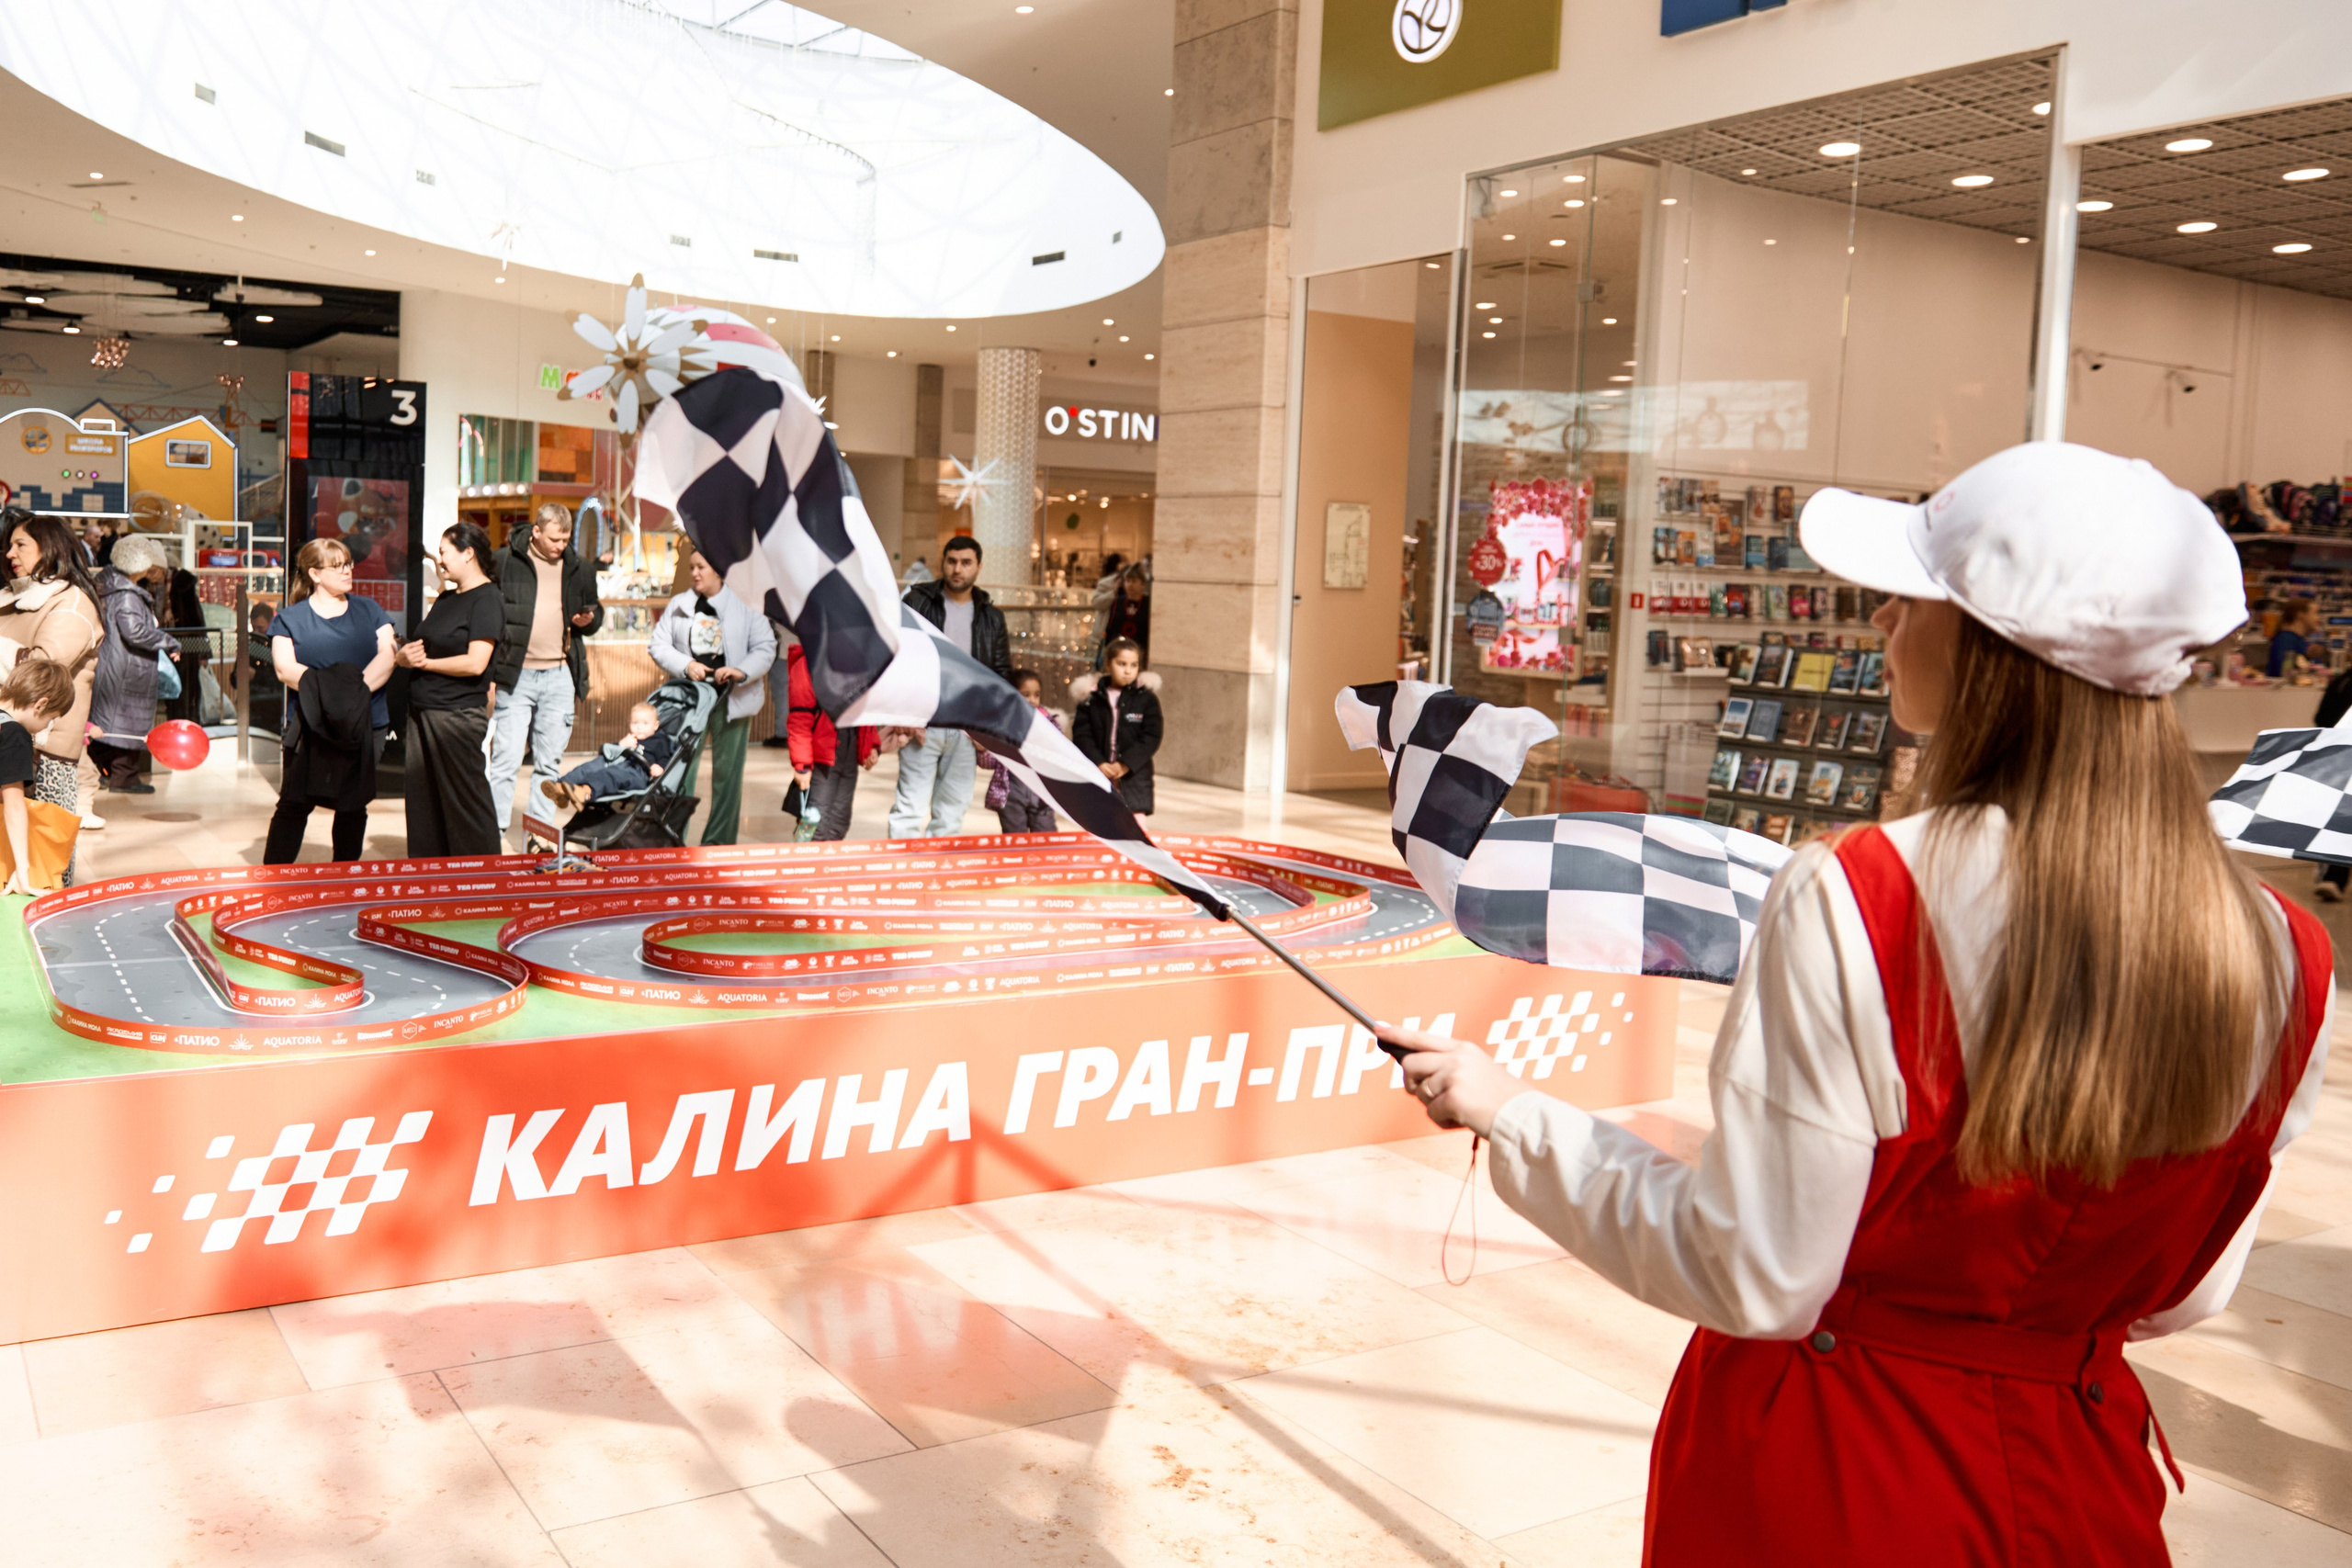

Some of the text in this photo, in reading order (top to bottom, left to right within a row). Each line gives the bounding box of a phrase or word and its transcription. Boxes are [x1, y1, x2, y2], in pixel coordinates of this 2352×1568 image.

[390, 389, 417, 426] 3
[1045, 405, 1155, 442] O'STIN
[161, 874, 198, 885] AQUATORIA
[665, 873, 698, 881] AQUATORIA
[108, 882, 134, 892] ПАТИО
[288, 894, 313, 902] INCANTO
[391, 909, 422, 918] ПАТИО
[1000, 976, 1040, 987] AQUATORIA
[644, 989, 681, 999] ПАТИО
[867, 986, 899, 995] INCANTO
[258, 997, 296, 1007] ПАТИО
[718, 994, 767, 1003] AQUATORIA
[71, 1019, 89, 1029] КАЛИНА
[435, 1016, 463, 1029] INCANTO
[177, 1035, 220, 1046] ПАТИО
[264, 1036, 322, 1047] AQUATORIA
[469, 1061, 972, 1207] КАЛИНА
